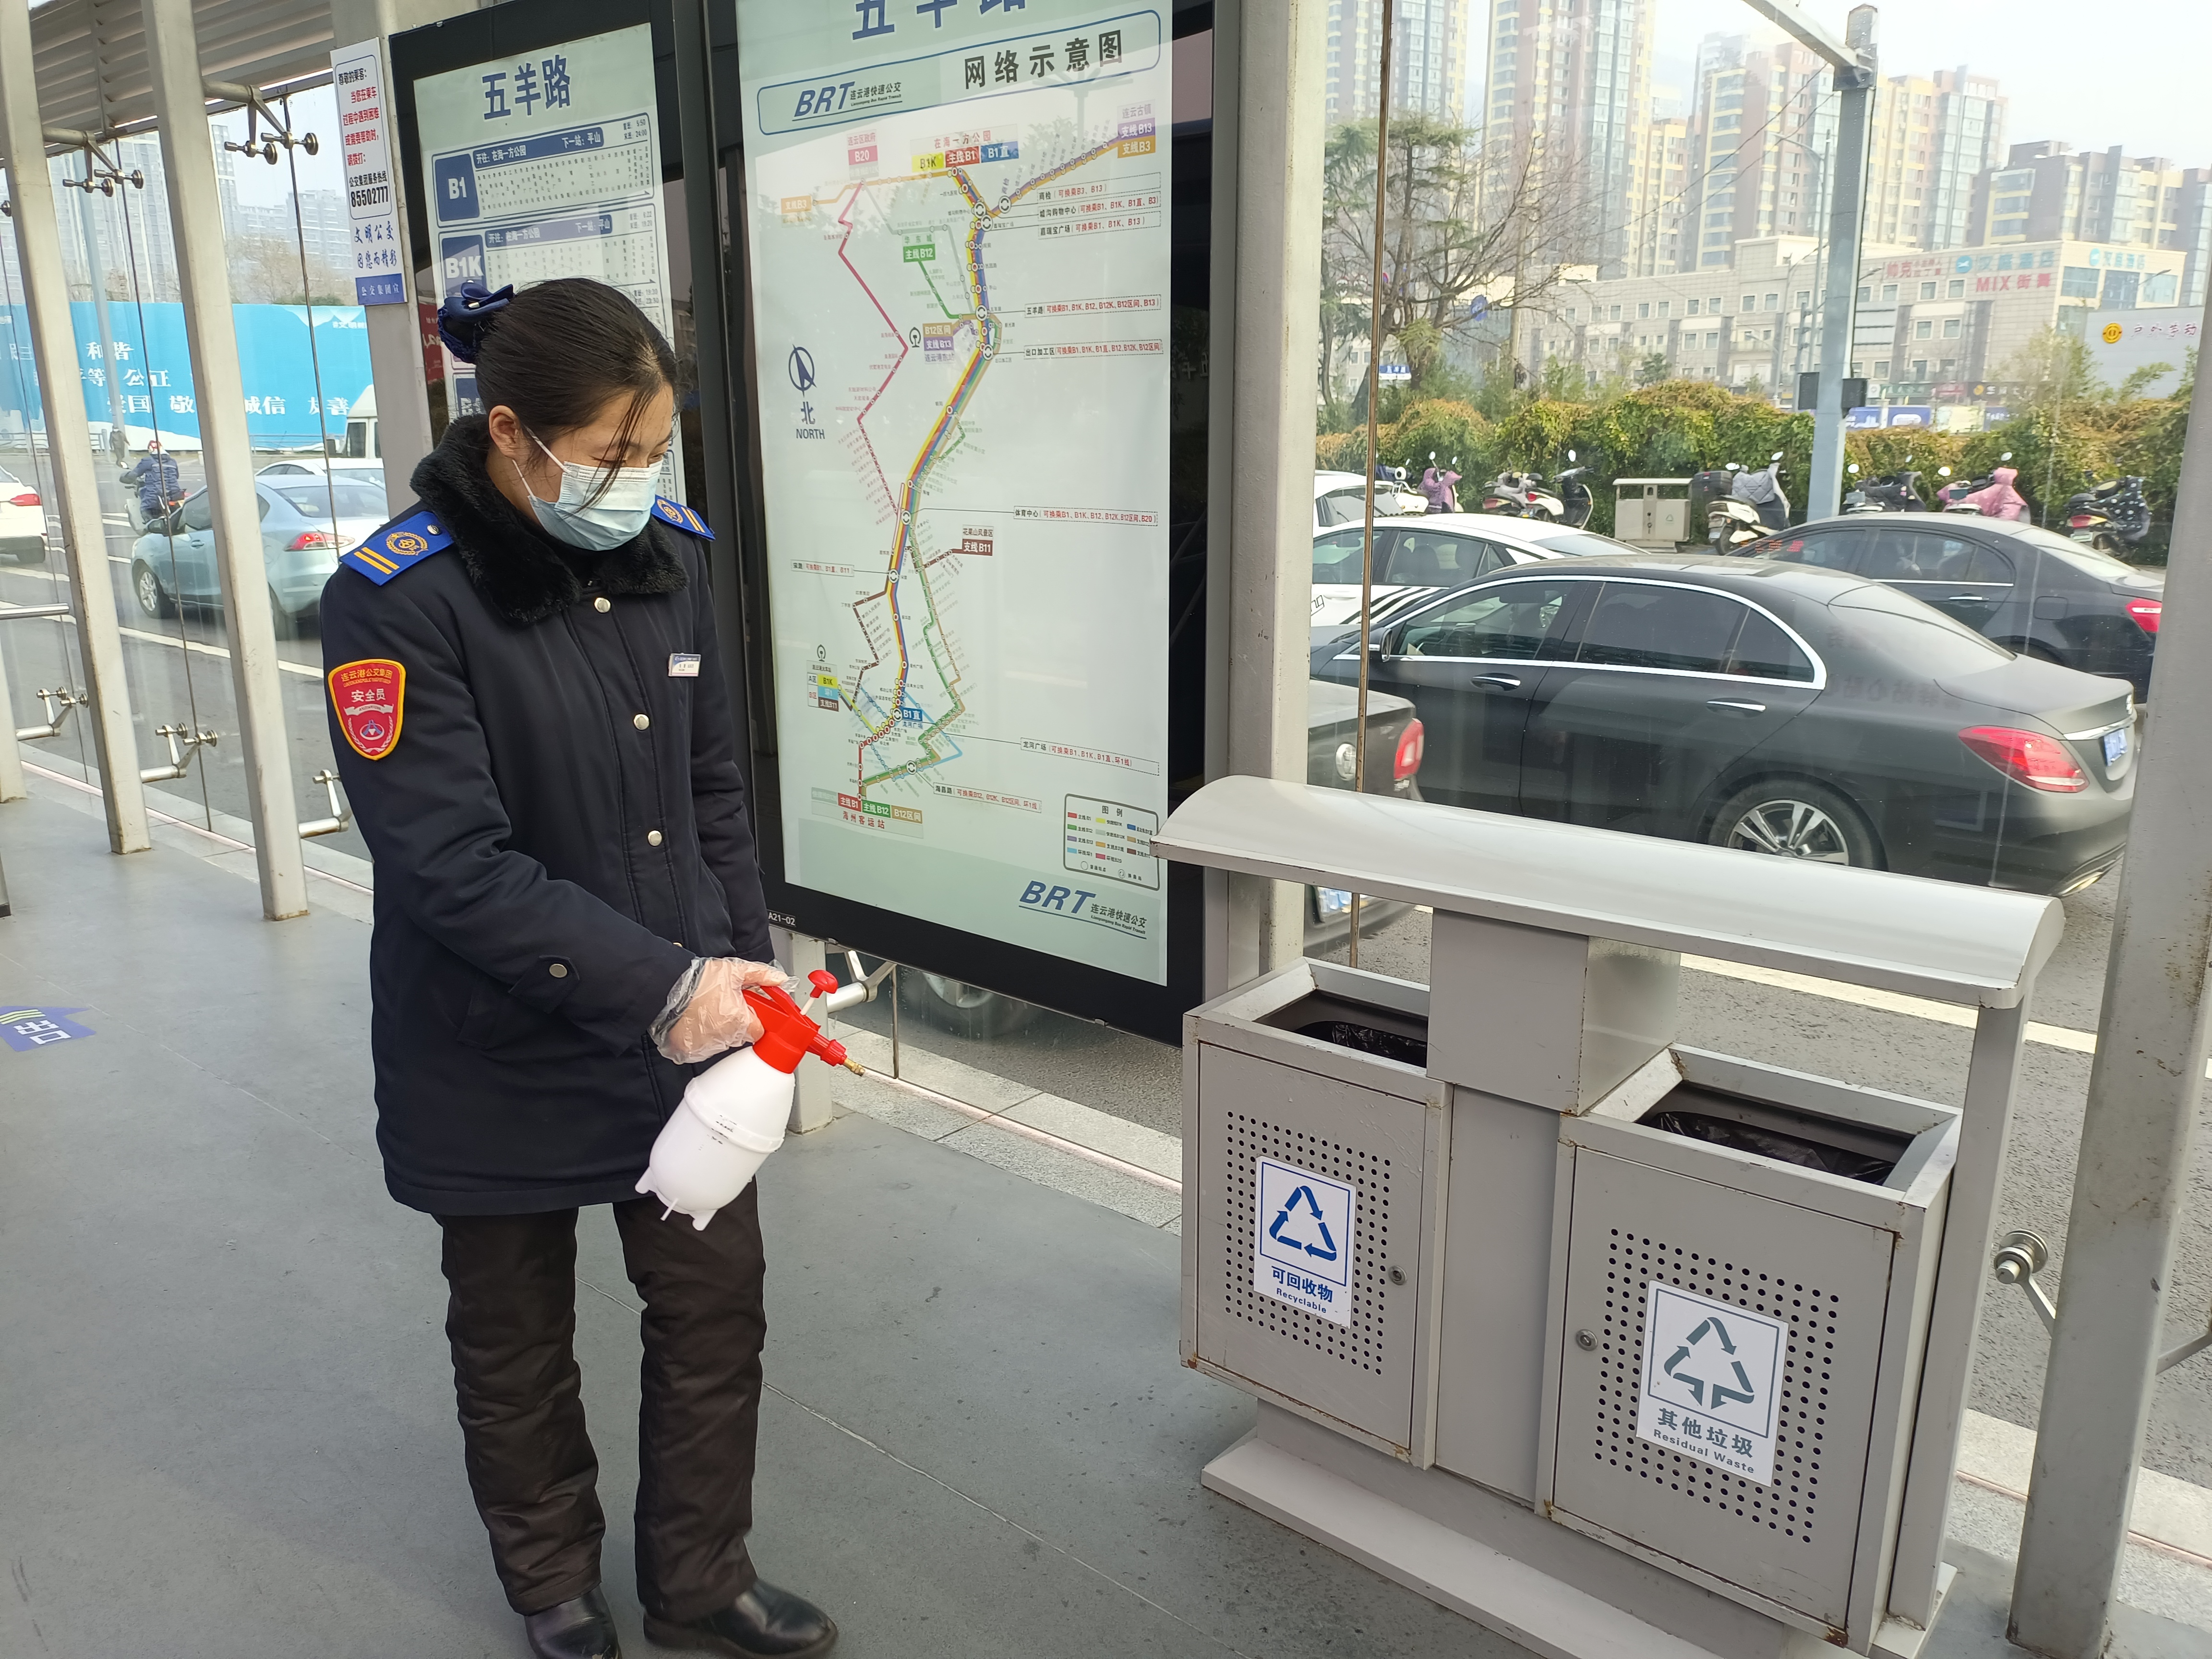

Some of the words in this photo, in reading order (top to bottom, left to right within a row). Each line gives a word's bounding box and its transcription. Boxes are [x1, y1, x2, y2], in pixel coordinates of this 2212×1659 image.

[964, 30, 1123, 90] 网络示意图
[482, 54, 571, 120] 五羊路
[850, 82, 902, 100] 连云港快速公交
[794, 82, 855, 117] BRT
[1121, 123, 1152, 138] 支线B13
[934, 131, 991, 149] 在海一方公园
[1122, 140, 1151, 155] 支线B3
[854, 150, 869, 162] B20
[948, 149, 976, 164] 主线B1
[988, 145, 1010, 159] B1直
[920, 156, 937, 169] B1K
[349, 171, 387, 187] 公交集团服务热线
[448, 177, 467, 199] B1
[351, 186, 389, 207] 85502777
[354, 220, 394, 243] 文明公交
[445, 255, 484, 278] B1K
[1976, 276, 2012, 292] MIX
[123, 369, 171, 387] 公正
[800, 401, 815, 424] 北
[796, 429, 825, 439] NORTH
[963, 541, 991, 553] 支线B11
[341, 669, 393, 682] 连云港公交集团
[351, 688, 385, 702] 安全员
[903, 710, 920, 720] B1直
[863, 803, 889, 815] 主线B12
[894, 809, 921, 822] B12区间
[1020, 880, 1096, 914] BRT
[769, 912, 796, 926] A21-02
[1091, 903, 1147, 928] 连云港快速公交
[13, 1020, 72, 1045] 出口
[1272, 1265, 1333, 1303] 可回收物
[1276, 1287, 1327, 1313] Recyclable
[1658, 1407, 1753, 1458] 其他垃圾
[1654, 1429, 1708, 1456] Residual
[1714, 1450, 1754, 1474] Waste
